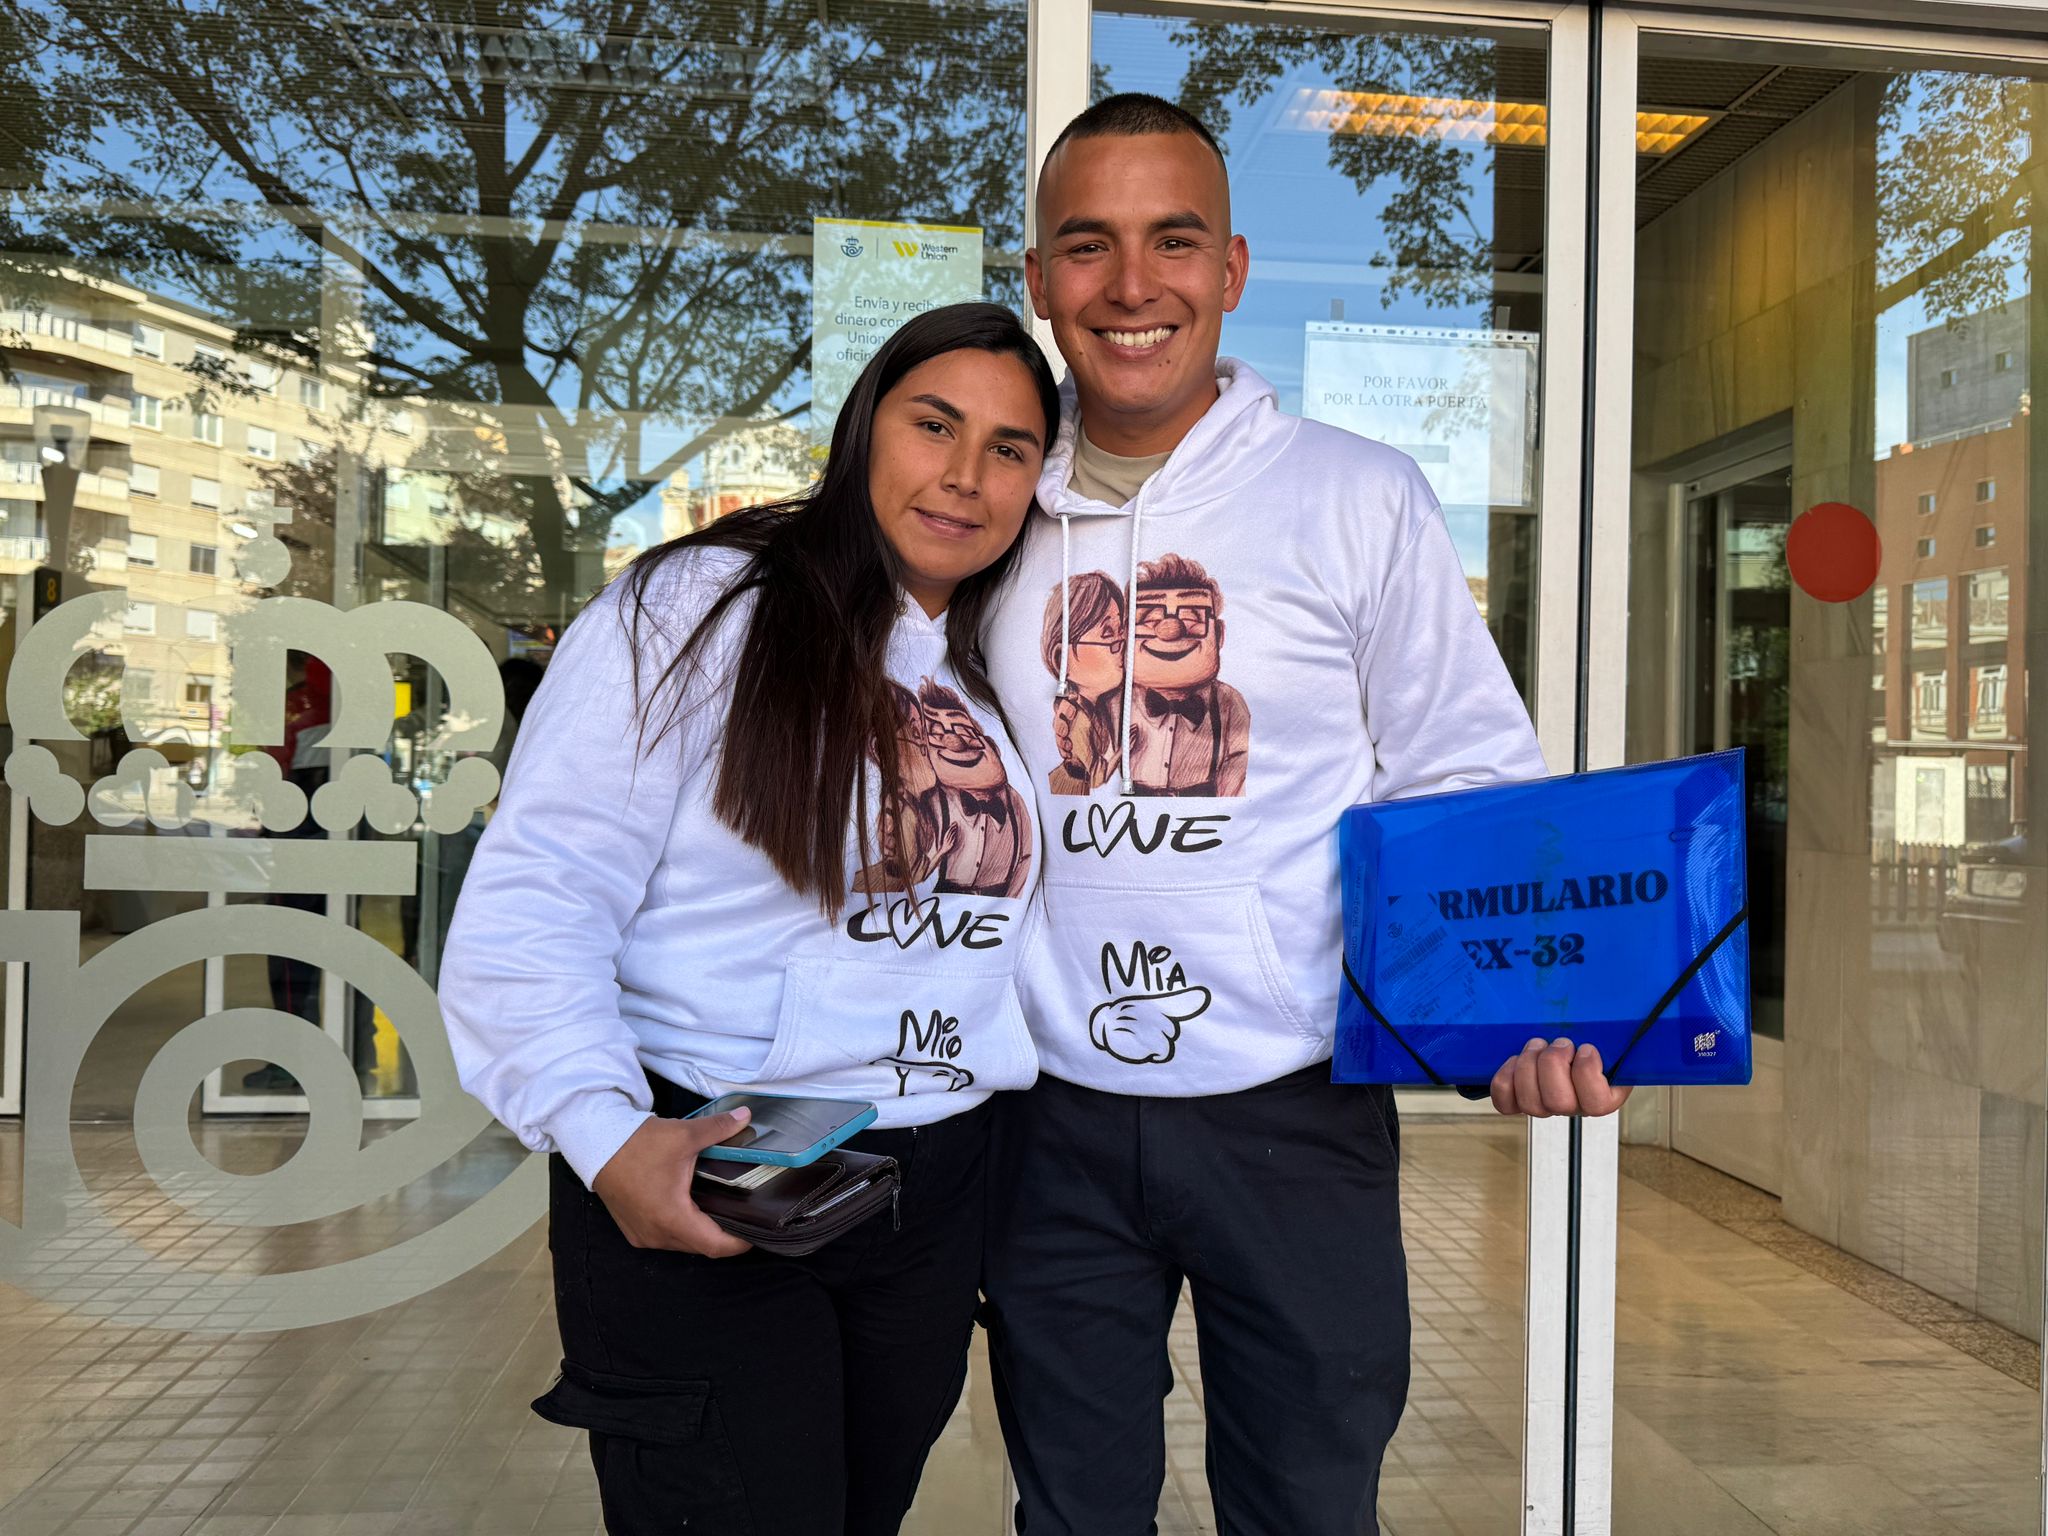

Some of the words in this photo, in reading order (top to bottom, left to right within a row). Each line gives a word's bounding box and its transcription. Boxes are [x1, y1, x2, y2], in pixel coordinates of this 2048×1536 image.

[921, 243, 958, 253] Western
[921, 251, 948, 261] Union
[855, 296, 889, 310] Envía
[892, 302, 900, 313] y
[835, 313, 877, 327] dinero
[847, 331, 885, 345] Union
[1363, 375, 1392, 389] POR
[1397, 376, 1448, 390] FAVOR
[1323, 392, 1353, 406] POR
[1358, 393, 1378, 406] LA
[1382, 394, 1423, 407] OTRA
[1428, 395, 1487, 409] PUERTA
[47, 576, 57, 603] 8
